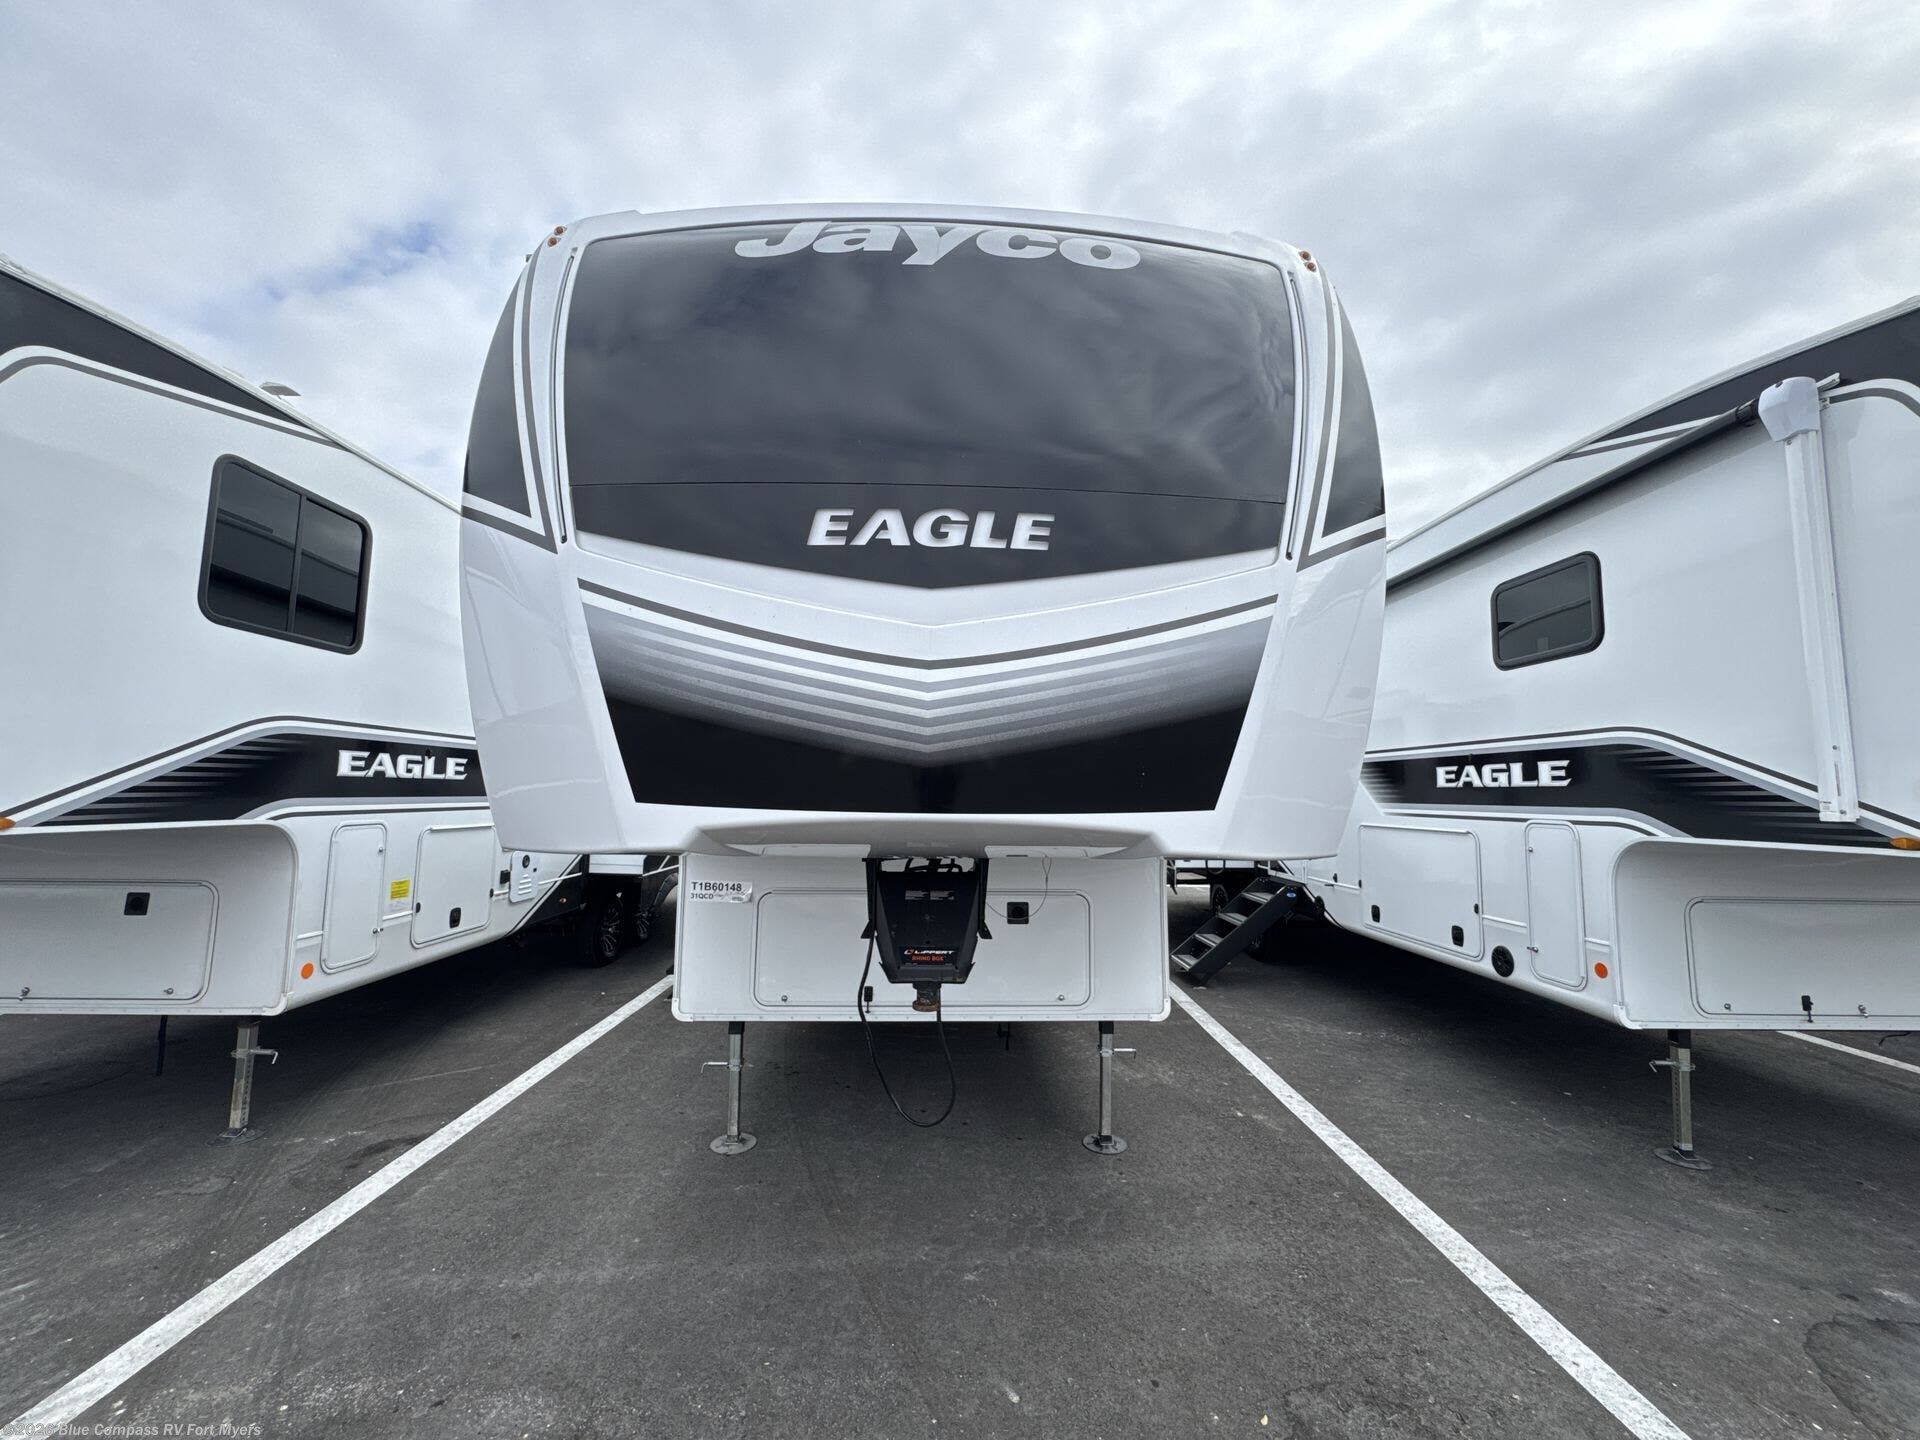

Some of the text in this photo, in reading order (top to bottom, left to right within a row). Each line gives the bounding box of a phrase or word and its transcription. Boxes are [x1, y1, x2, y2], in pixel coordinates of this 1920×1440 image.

[734, 220, 1141, 270] Jayco
[806, 508, 1056, 551] EAGLE
[336, 749, 469, 780] EAGLE
[1435, 759, 1573, 788] EAGLE
[691, 881, 742, 892] T1B60148
